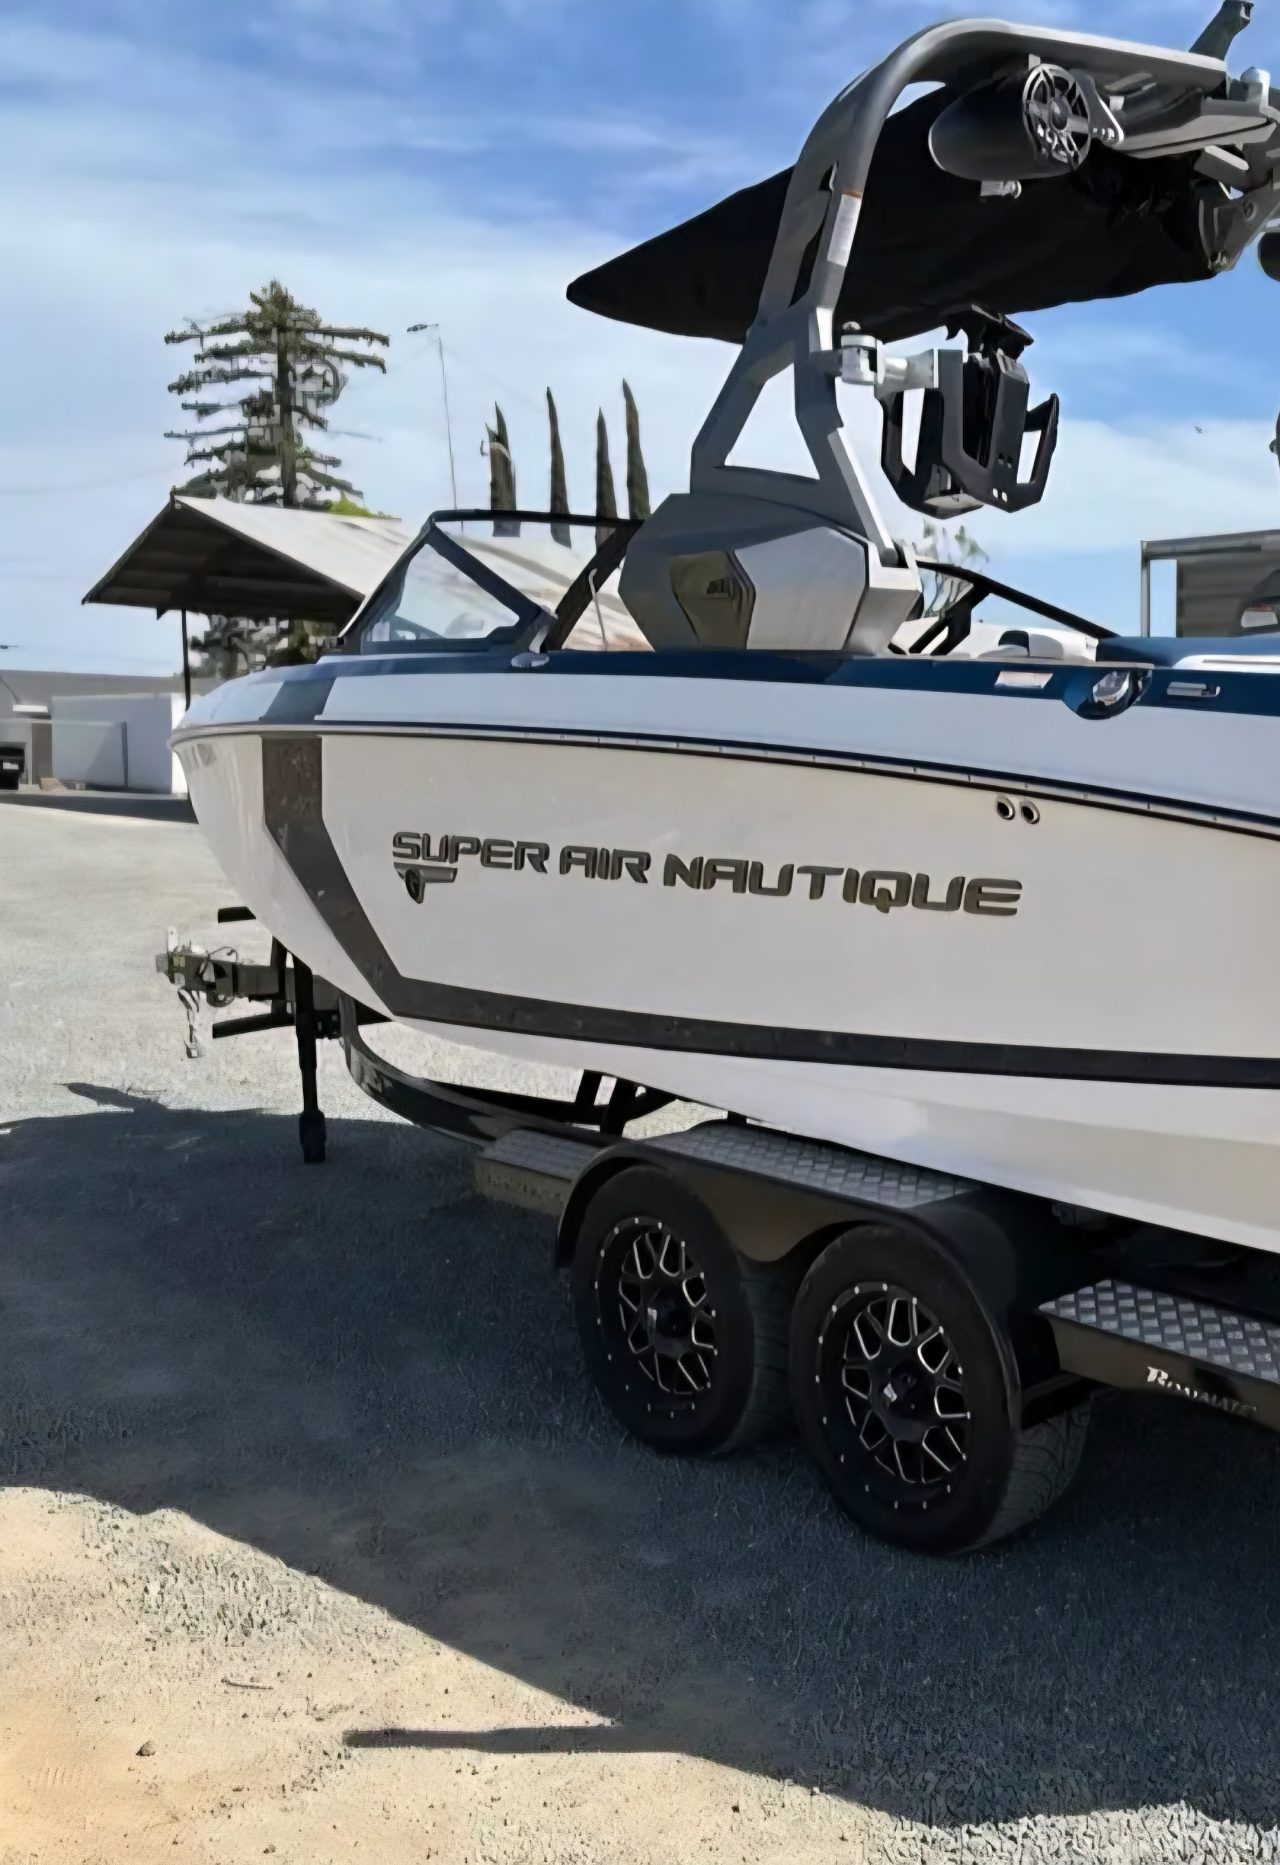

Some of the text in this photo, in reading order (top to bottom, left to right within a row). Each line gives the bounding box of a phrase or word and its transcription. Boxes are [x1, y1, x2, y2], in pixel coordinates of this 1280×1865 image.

[392, 831, 1024, 916] SUPER AIR NAUTIQUE
